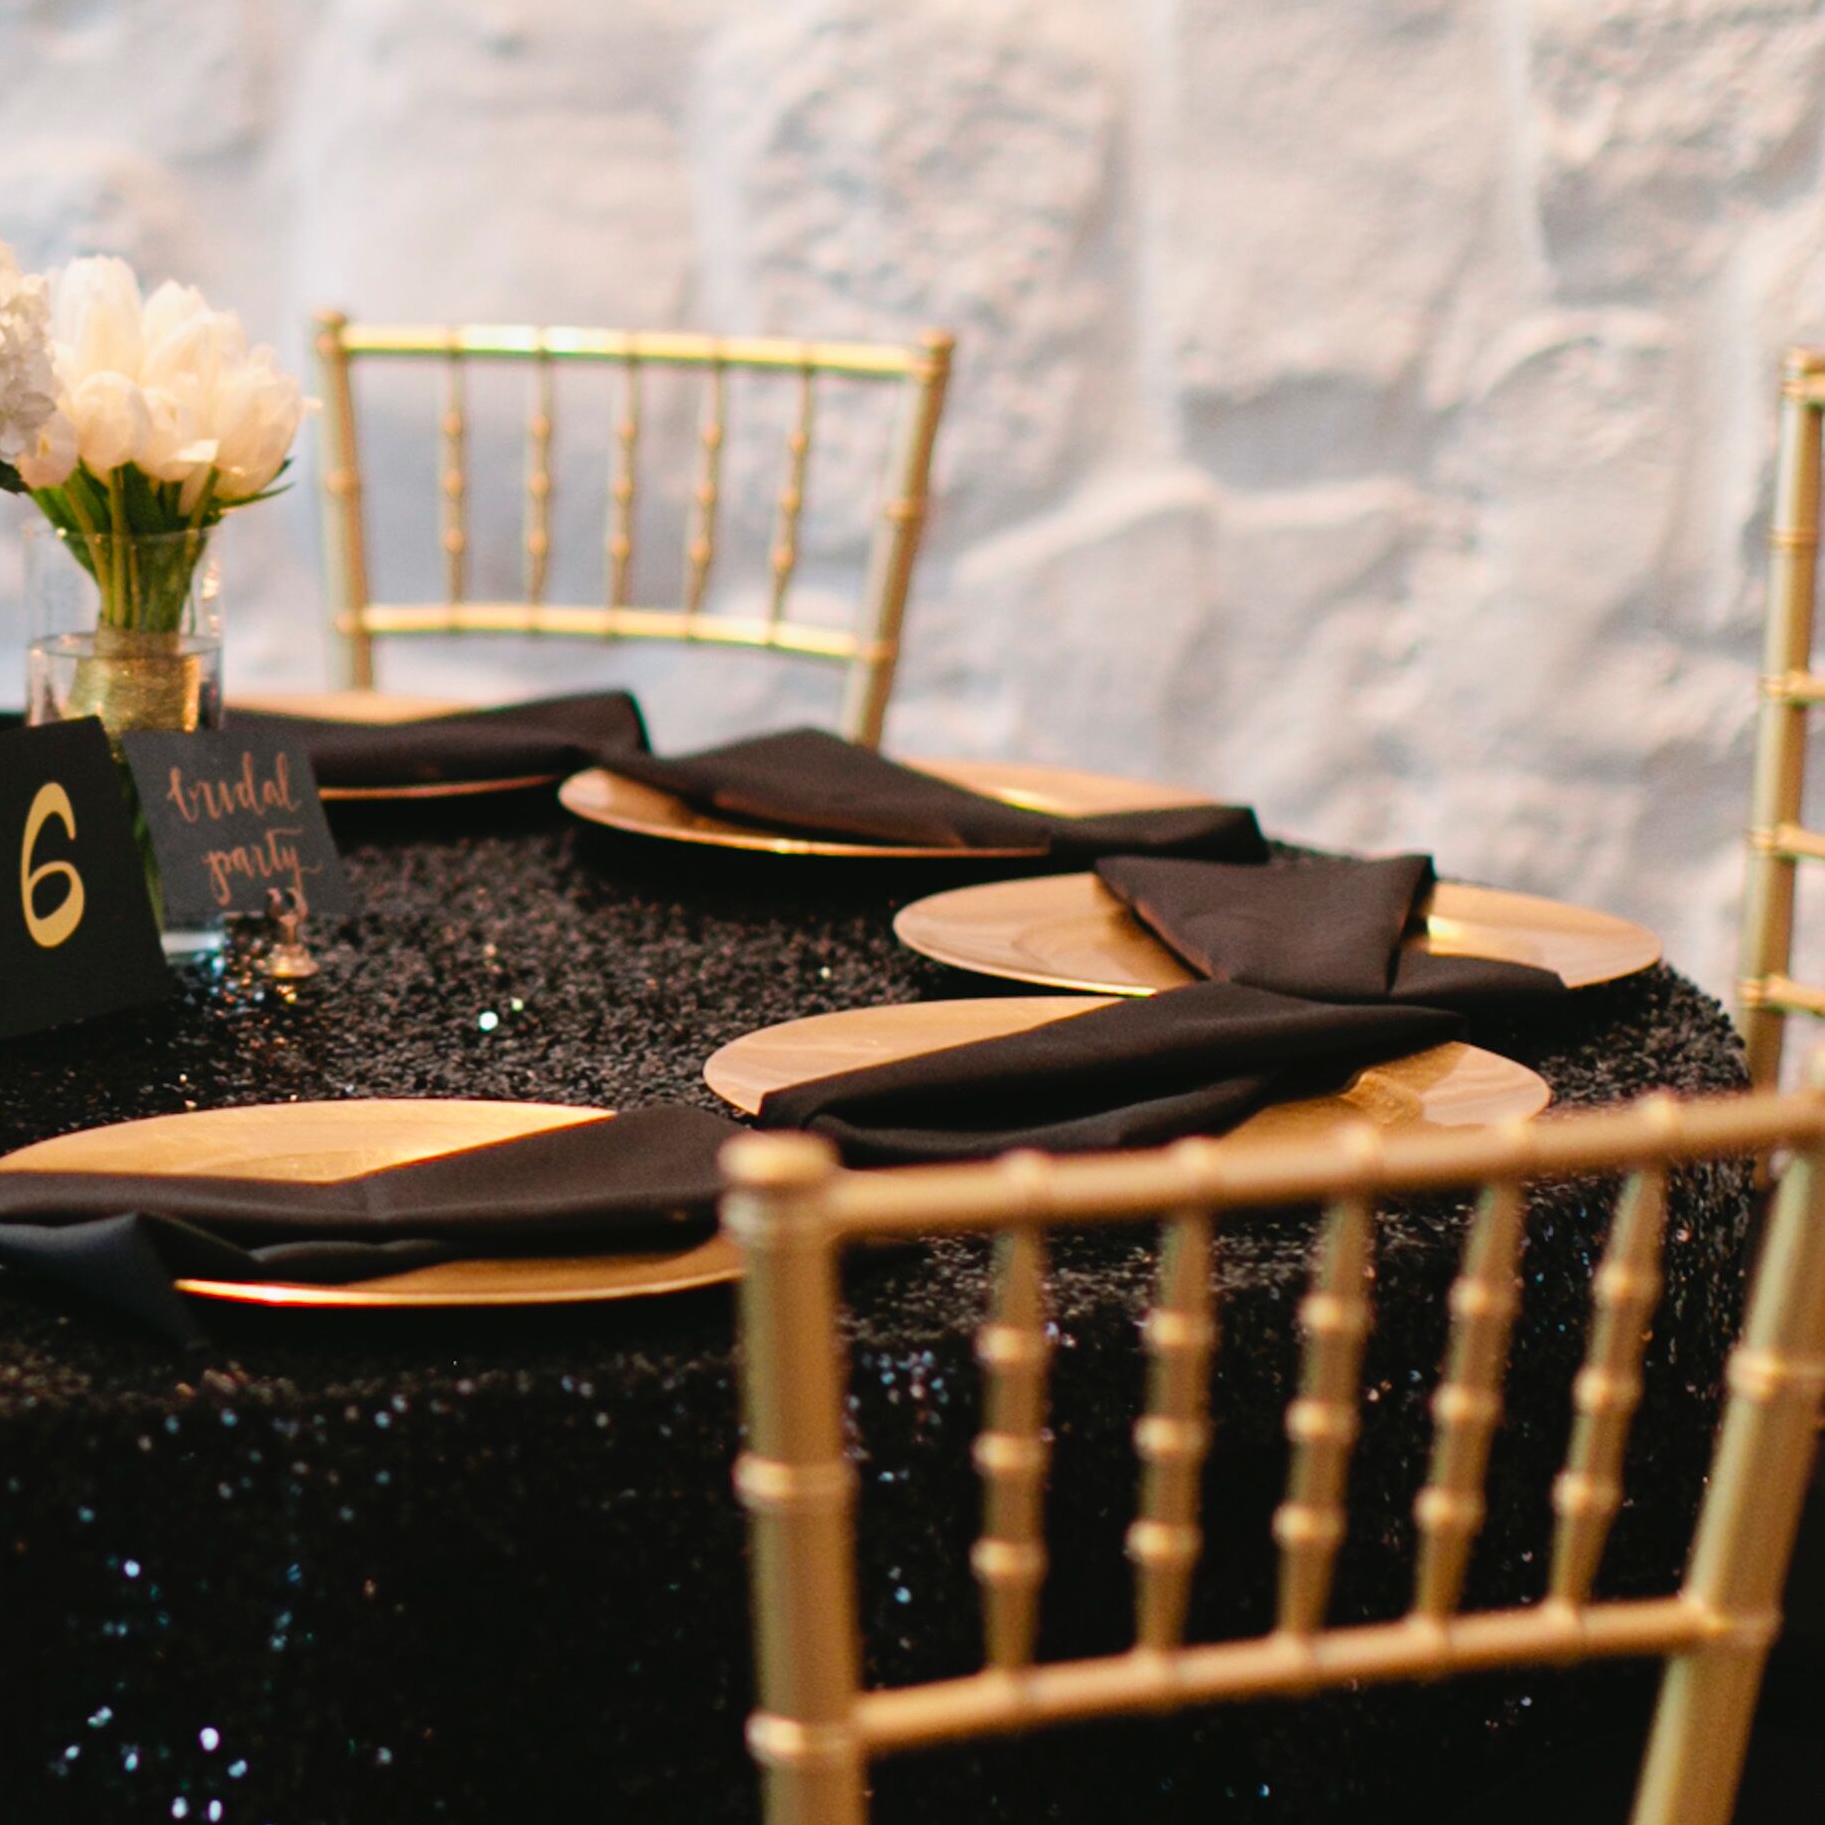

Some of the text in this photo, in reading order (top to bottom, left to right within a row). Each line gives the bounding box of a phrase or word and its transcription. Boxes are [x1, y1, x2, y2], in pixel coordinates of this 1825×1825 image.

[167, 750, 302, 825] bridal
[19, 781, 86, 949] 6
[202, 827, 324, 907] party
